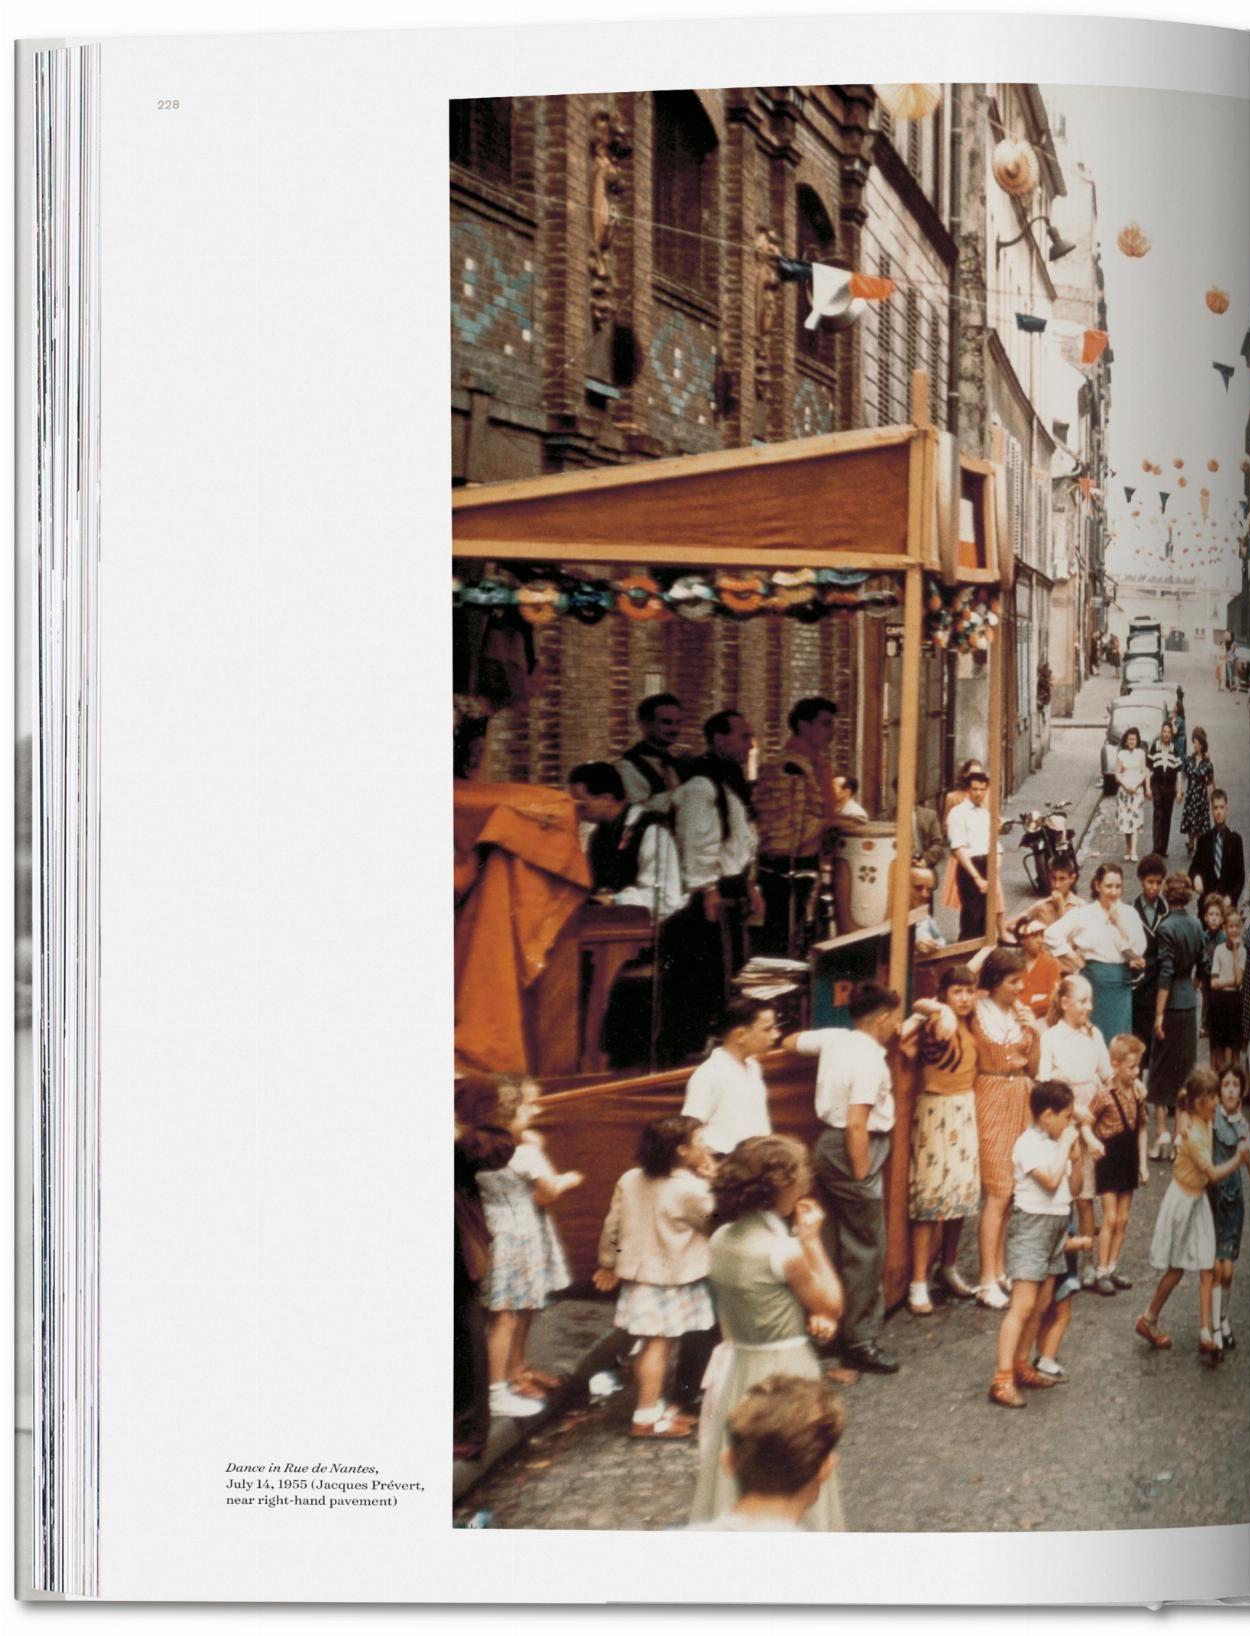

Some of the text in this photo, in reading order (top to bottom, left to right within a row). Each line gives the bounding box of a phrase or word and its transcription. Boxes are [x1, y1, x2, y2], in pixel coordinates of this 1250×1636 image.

[157, 99, 180, 110] 228
[225, 1462, 379, 1476] Dance in Rue de Nantes,
[225, 1478, 425, 1492] July 14, 1955 (Jacques Prévert,
[226, 1494, 398, 1509] near right-hand pavement)
